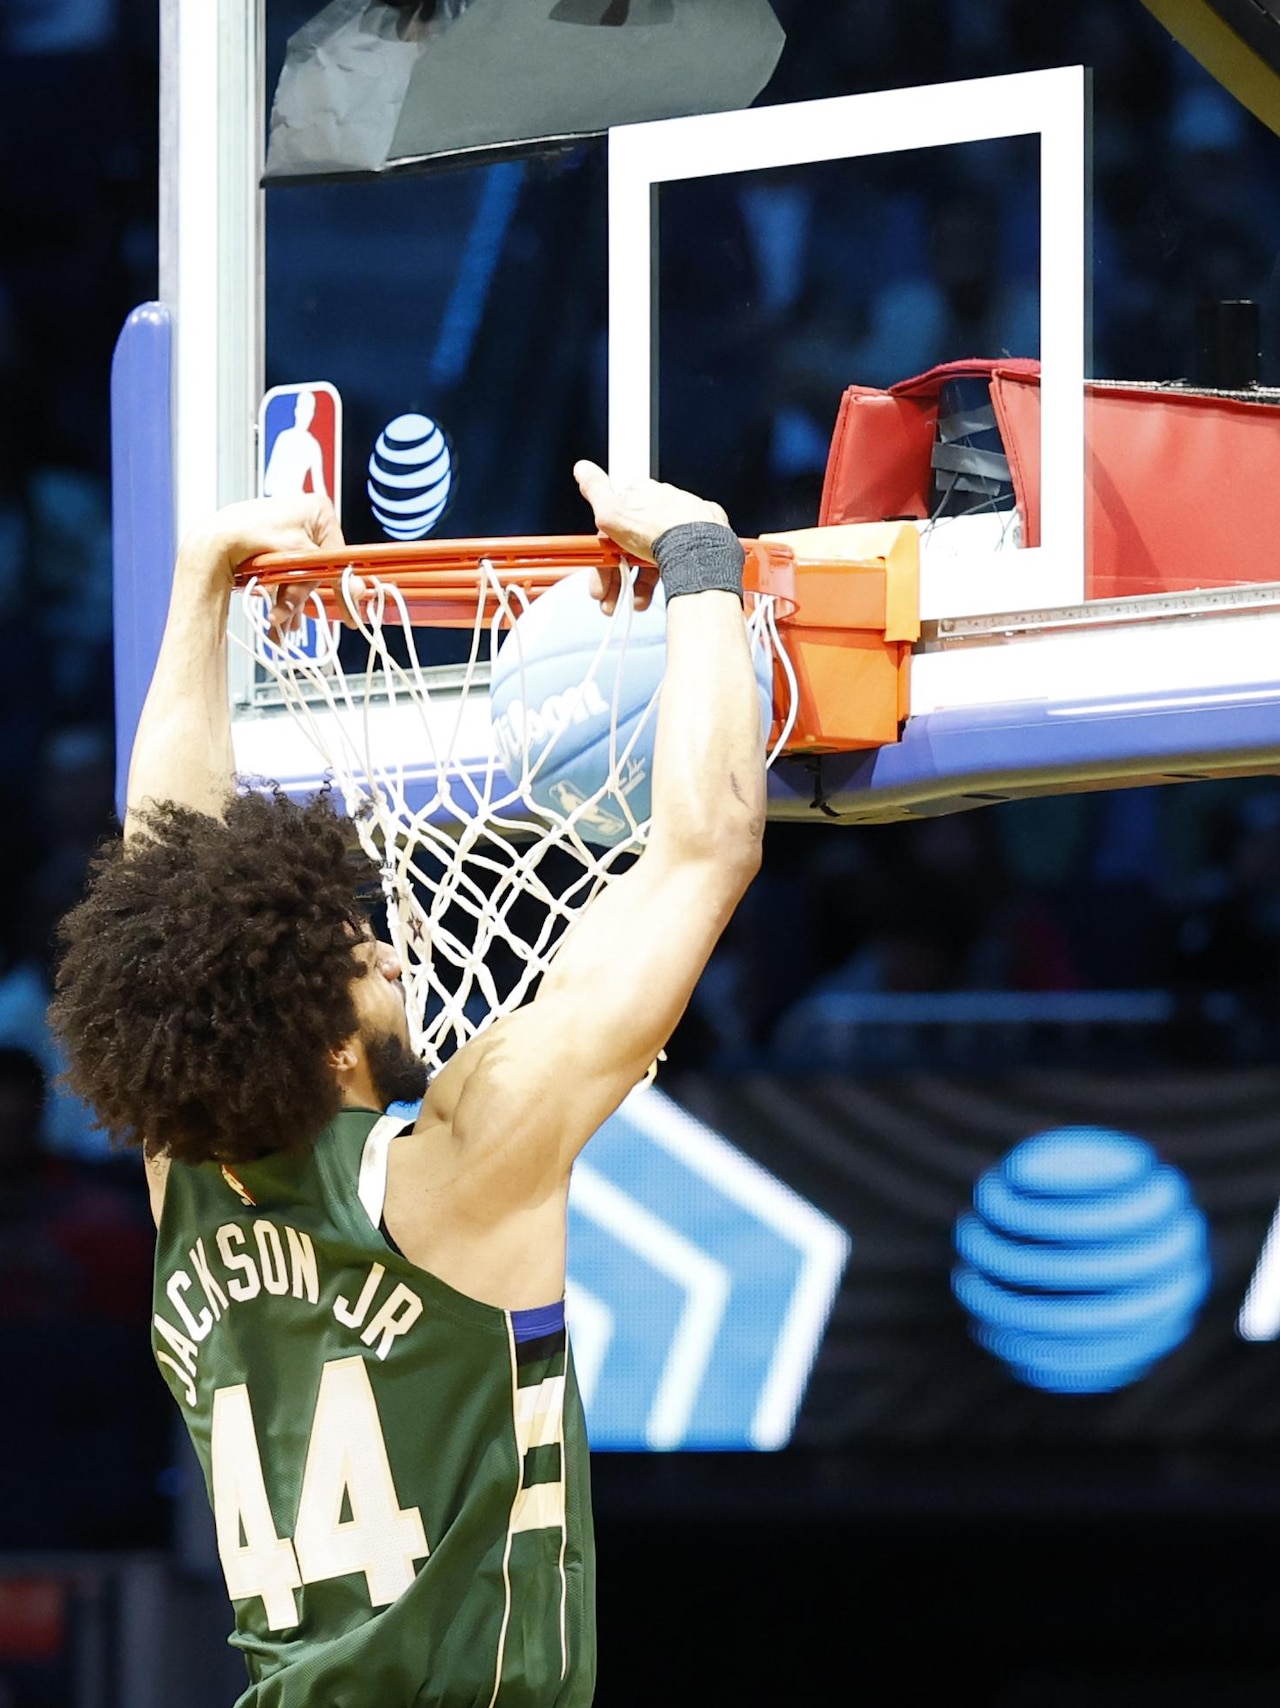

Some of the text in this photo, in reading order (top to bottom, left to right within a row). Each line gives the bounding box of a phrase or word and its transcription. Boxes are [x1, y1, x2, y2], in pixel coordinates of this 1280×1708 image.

[153, 1219, 423, 1407] JACKSON JR
[211, 1355, 430, 1631] 44
